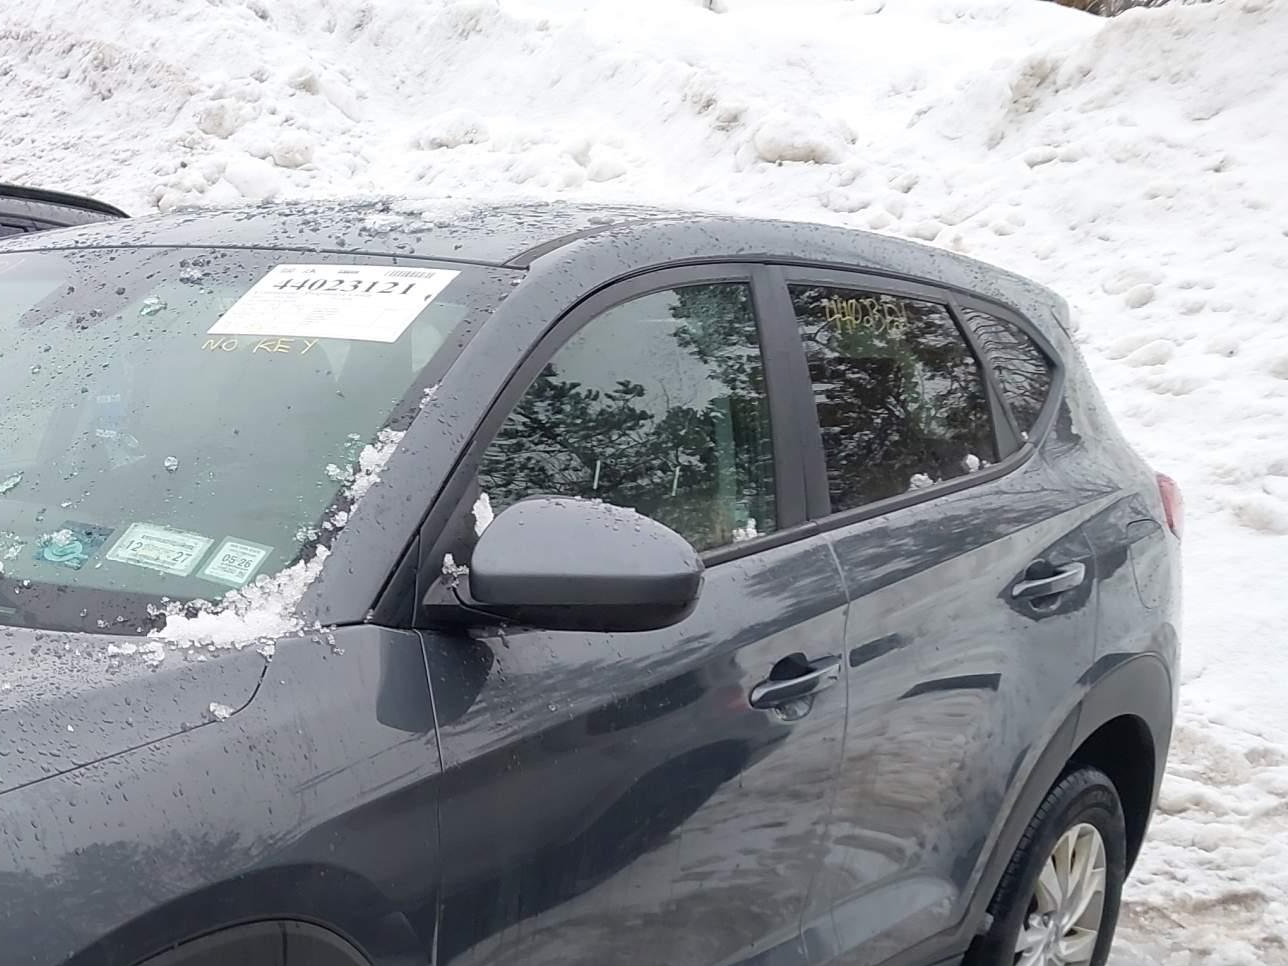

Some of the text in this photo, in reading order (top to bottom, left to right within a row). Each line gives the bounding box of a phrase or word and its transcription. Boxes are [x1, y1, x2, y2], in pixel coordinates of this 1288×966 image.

[273, 278, 416, 295] 44023121
[201, 338, 319, 354] NO KEY
[126, 539, 143, 553] 12
[172, 551, 193, 565] 27
